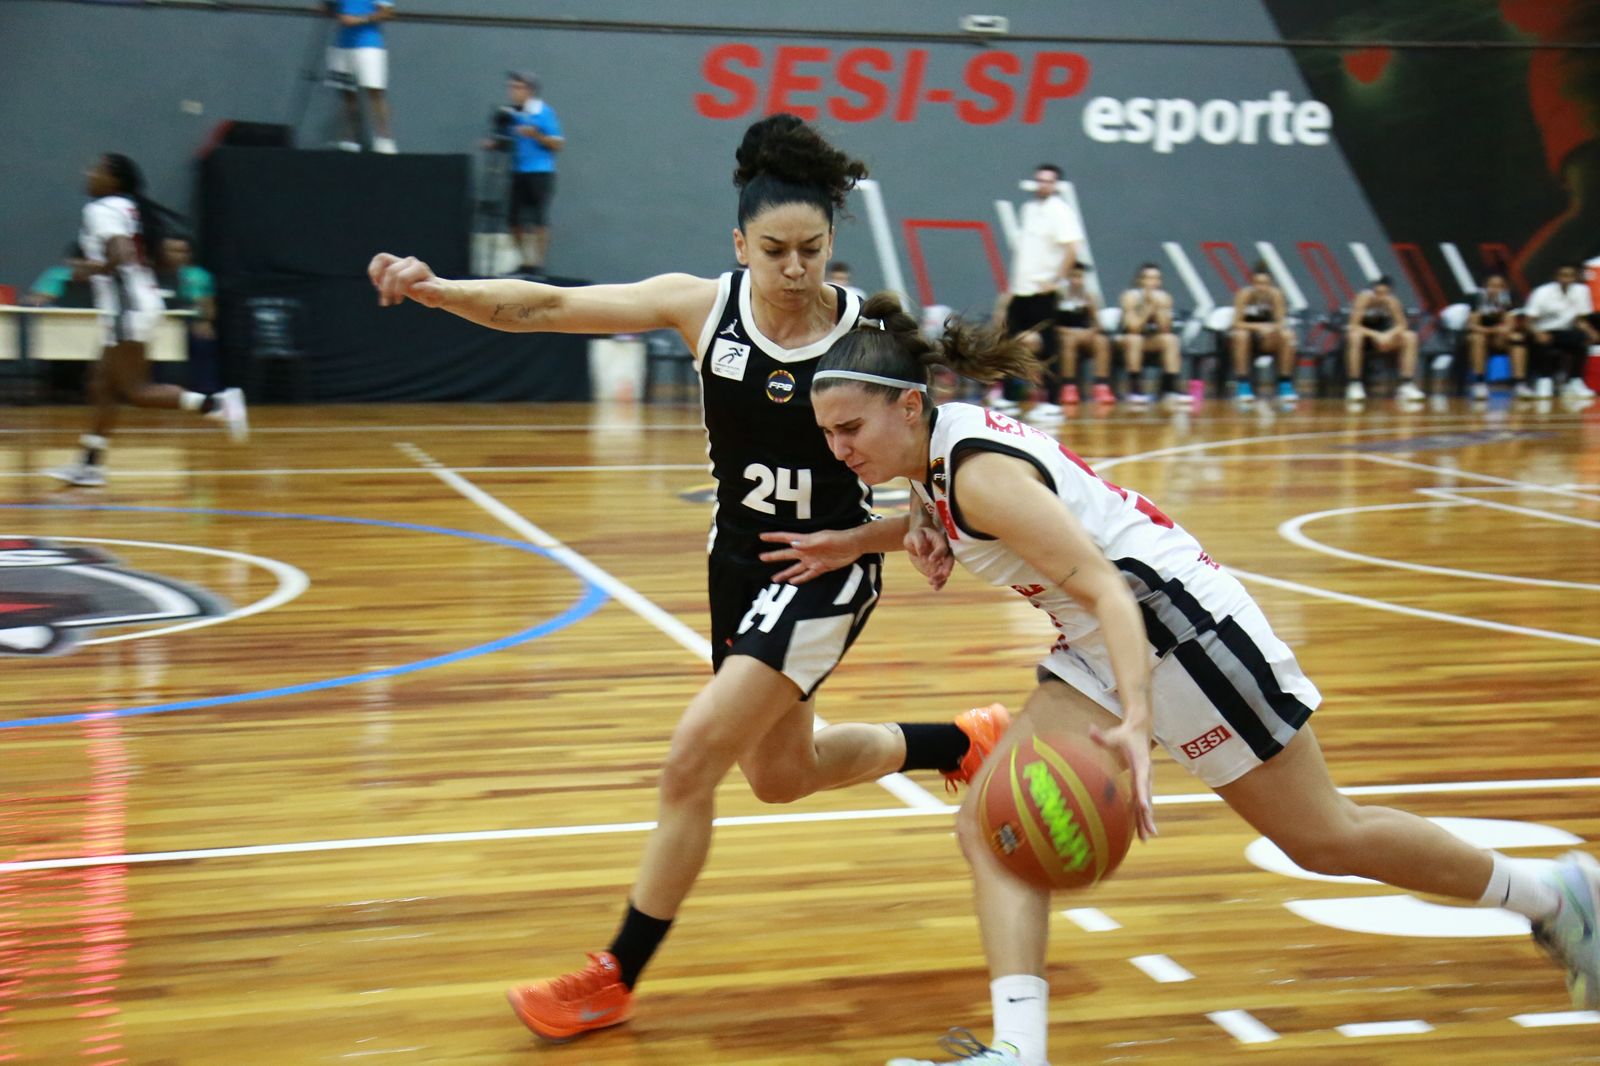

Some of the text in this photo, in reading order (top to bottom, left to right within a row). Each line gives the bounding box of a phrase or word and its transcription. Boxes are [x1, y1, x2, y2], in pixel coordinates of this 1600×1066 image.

[694, 43, 1091, 124] SESI-SP
[1083, 90, 1331, 152] esporte
[768, 381, 793, 392] FPB
[741, 463, 812, 519] 24
[1187, 728, 1226, 757] SESI
